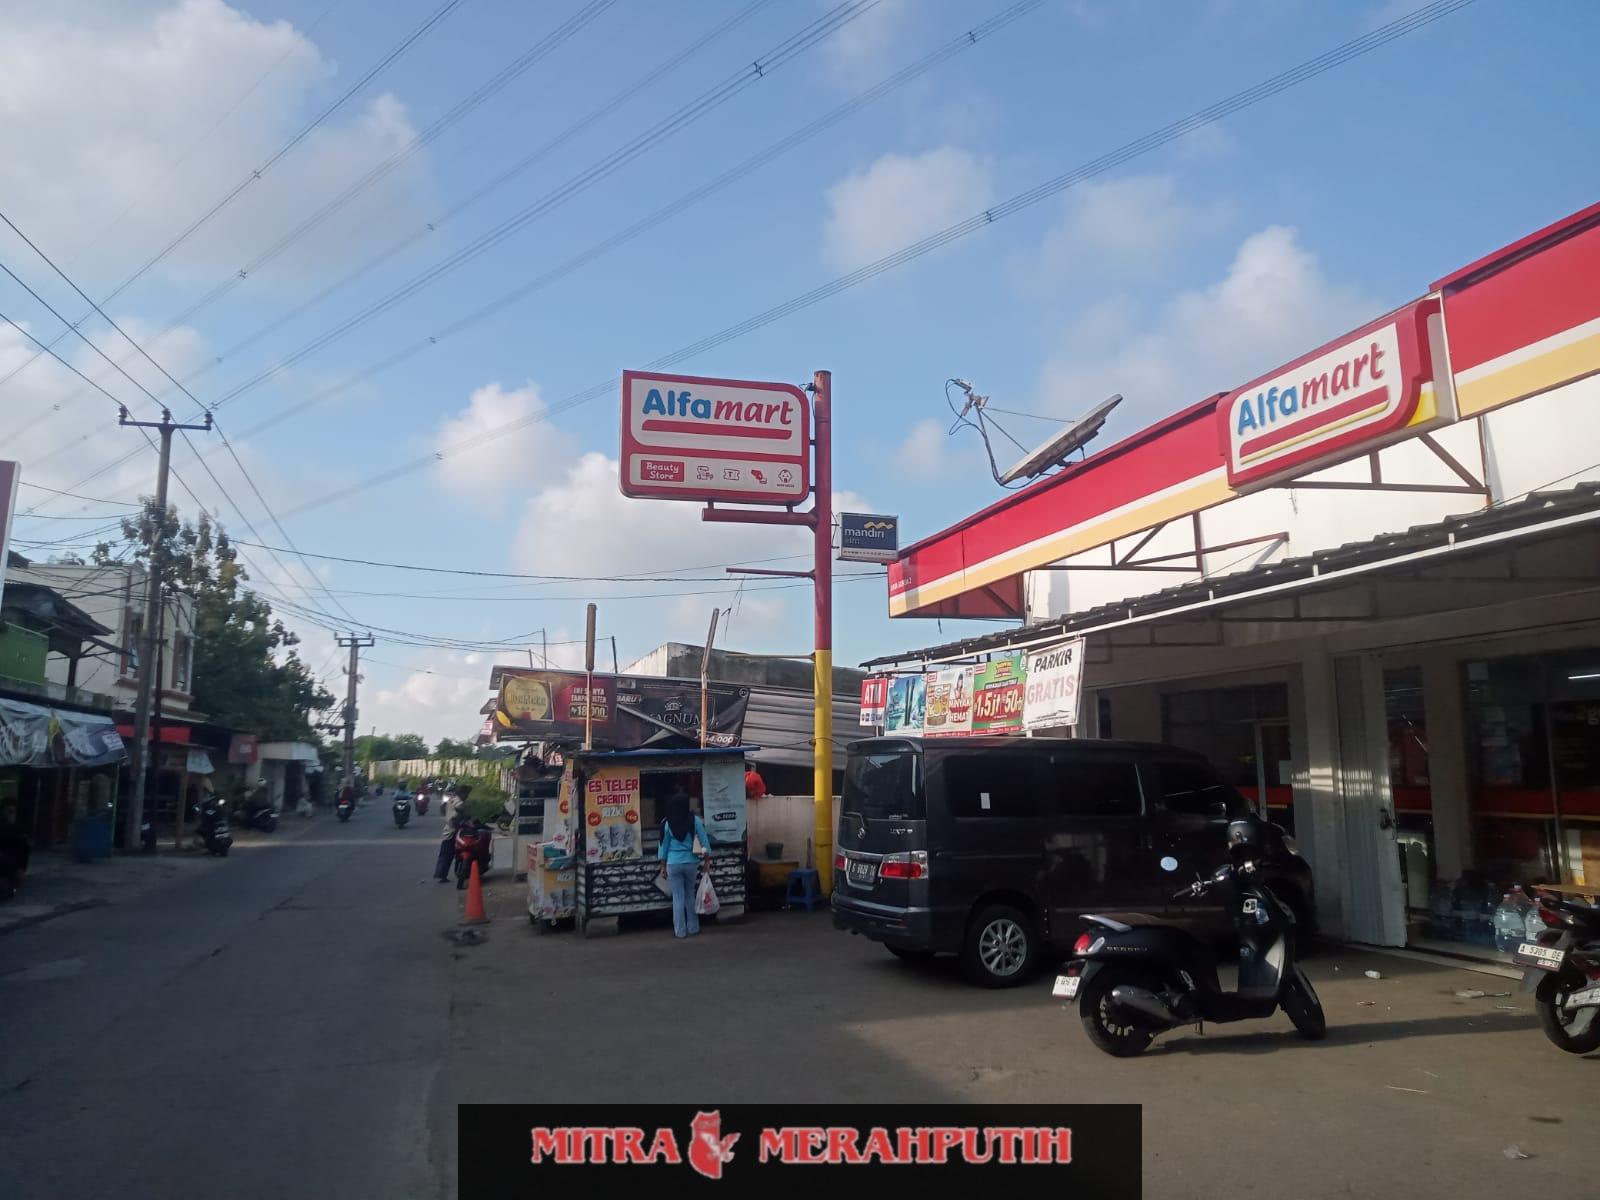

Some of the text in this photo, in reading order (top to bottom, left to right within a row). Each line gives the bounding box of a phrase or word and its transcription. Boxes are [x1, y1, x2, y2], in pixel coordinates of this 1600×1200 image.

[1238, 343, 1385, 435] Alfamart
[642, 389, 793, 424] Alfamart
[646, 462, 679, 473] Beauty
[649, 471, 674, 479] Store
[844, 528, 885, 538] mandiri
[1034, 648, 1072, 673] PARKIR
[1026, 674, 1075, 705] GRATIS
[589, 779, 638, 792] ES TELER
[597, 793, 631, 805] CREAMY
